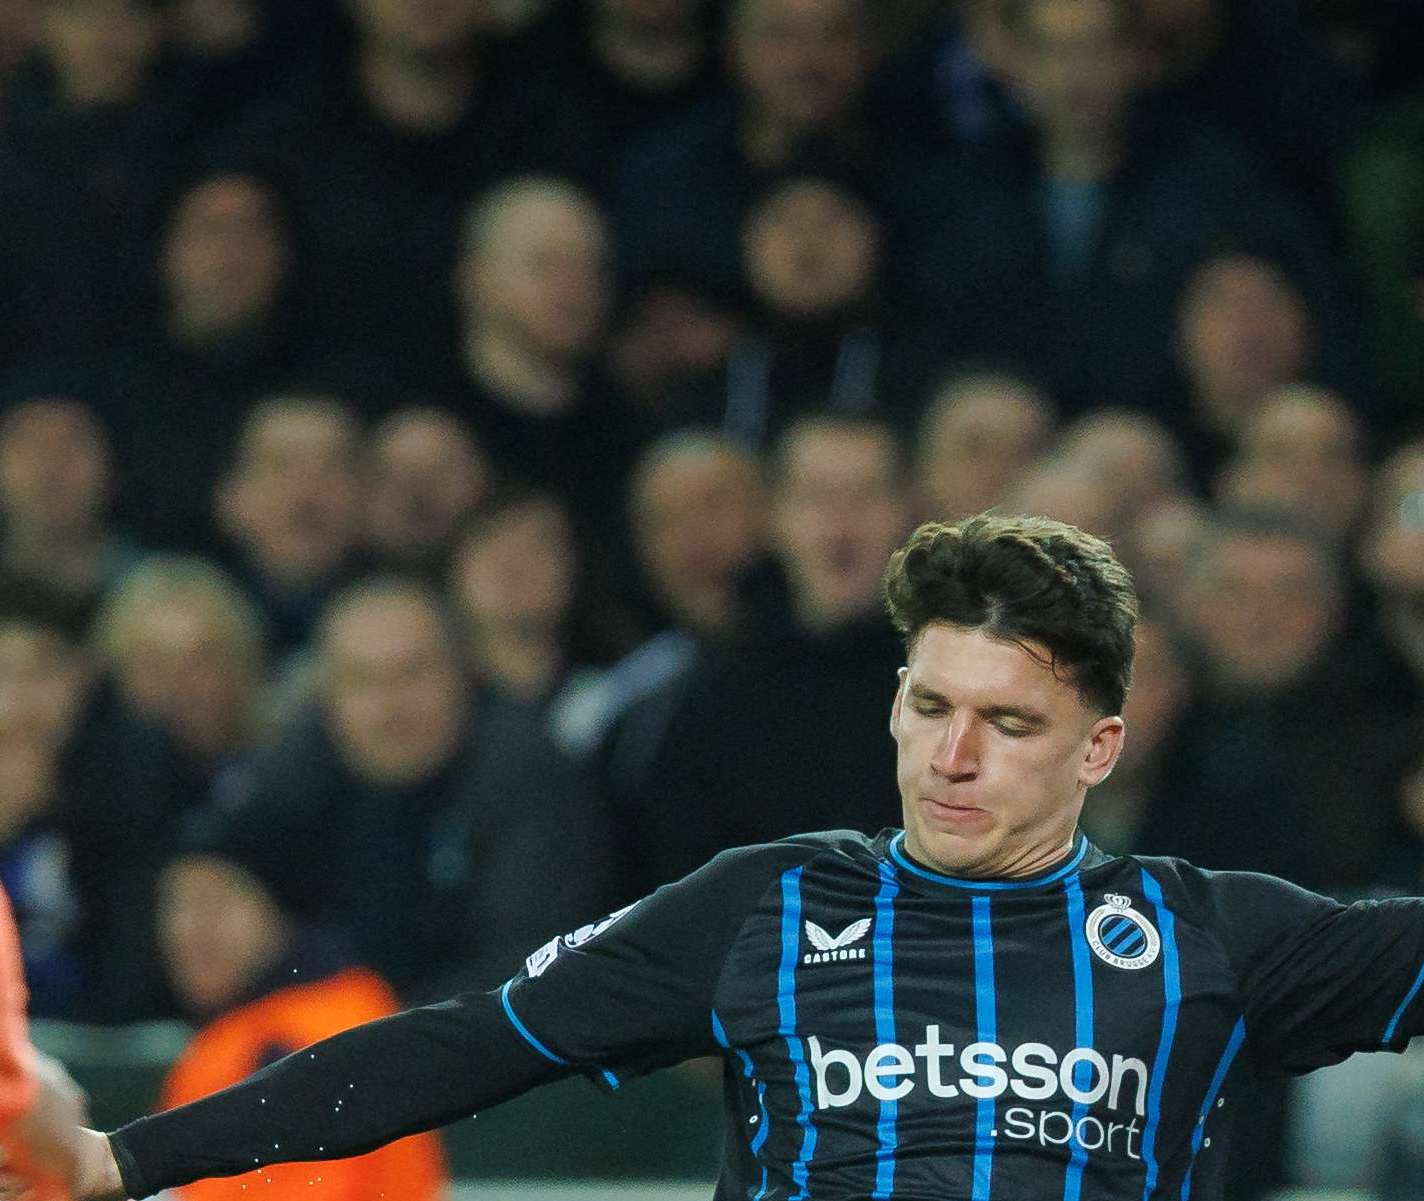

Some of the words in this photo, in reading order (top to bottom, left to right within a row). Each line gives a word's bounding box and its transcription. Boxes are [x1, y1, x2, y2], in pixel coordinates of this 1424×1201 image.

[804, 948, 866, 964] CASTORE
[808, 1024, 1148, 1116] betsson
[989, 1106, 1141, 1160] .sport
